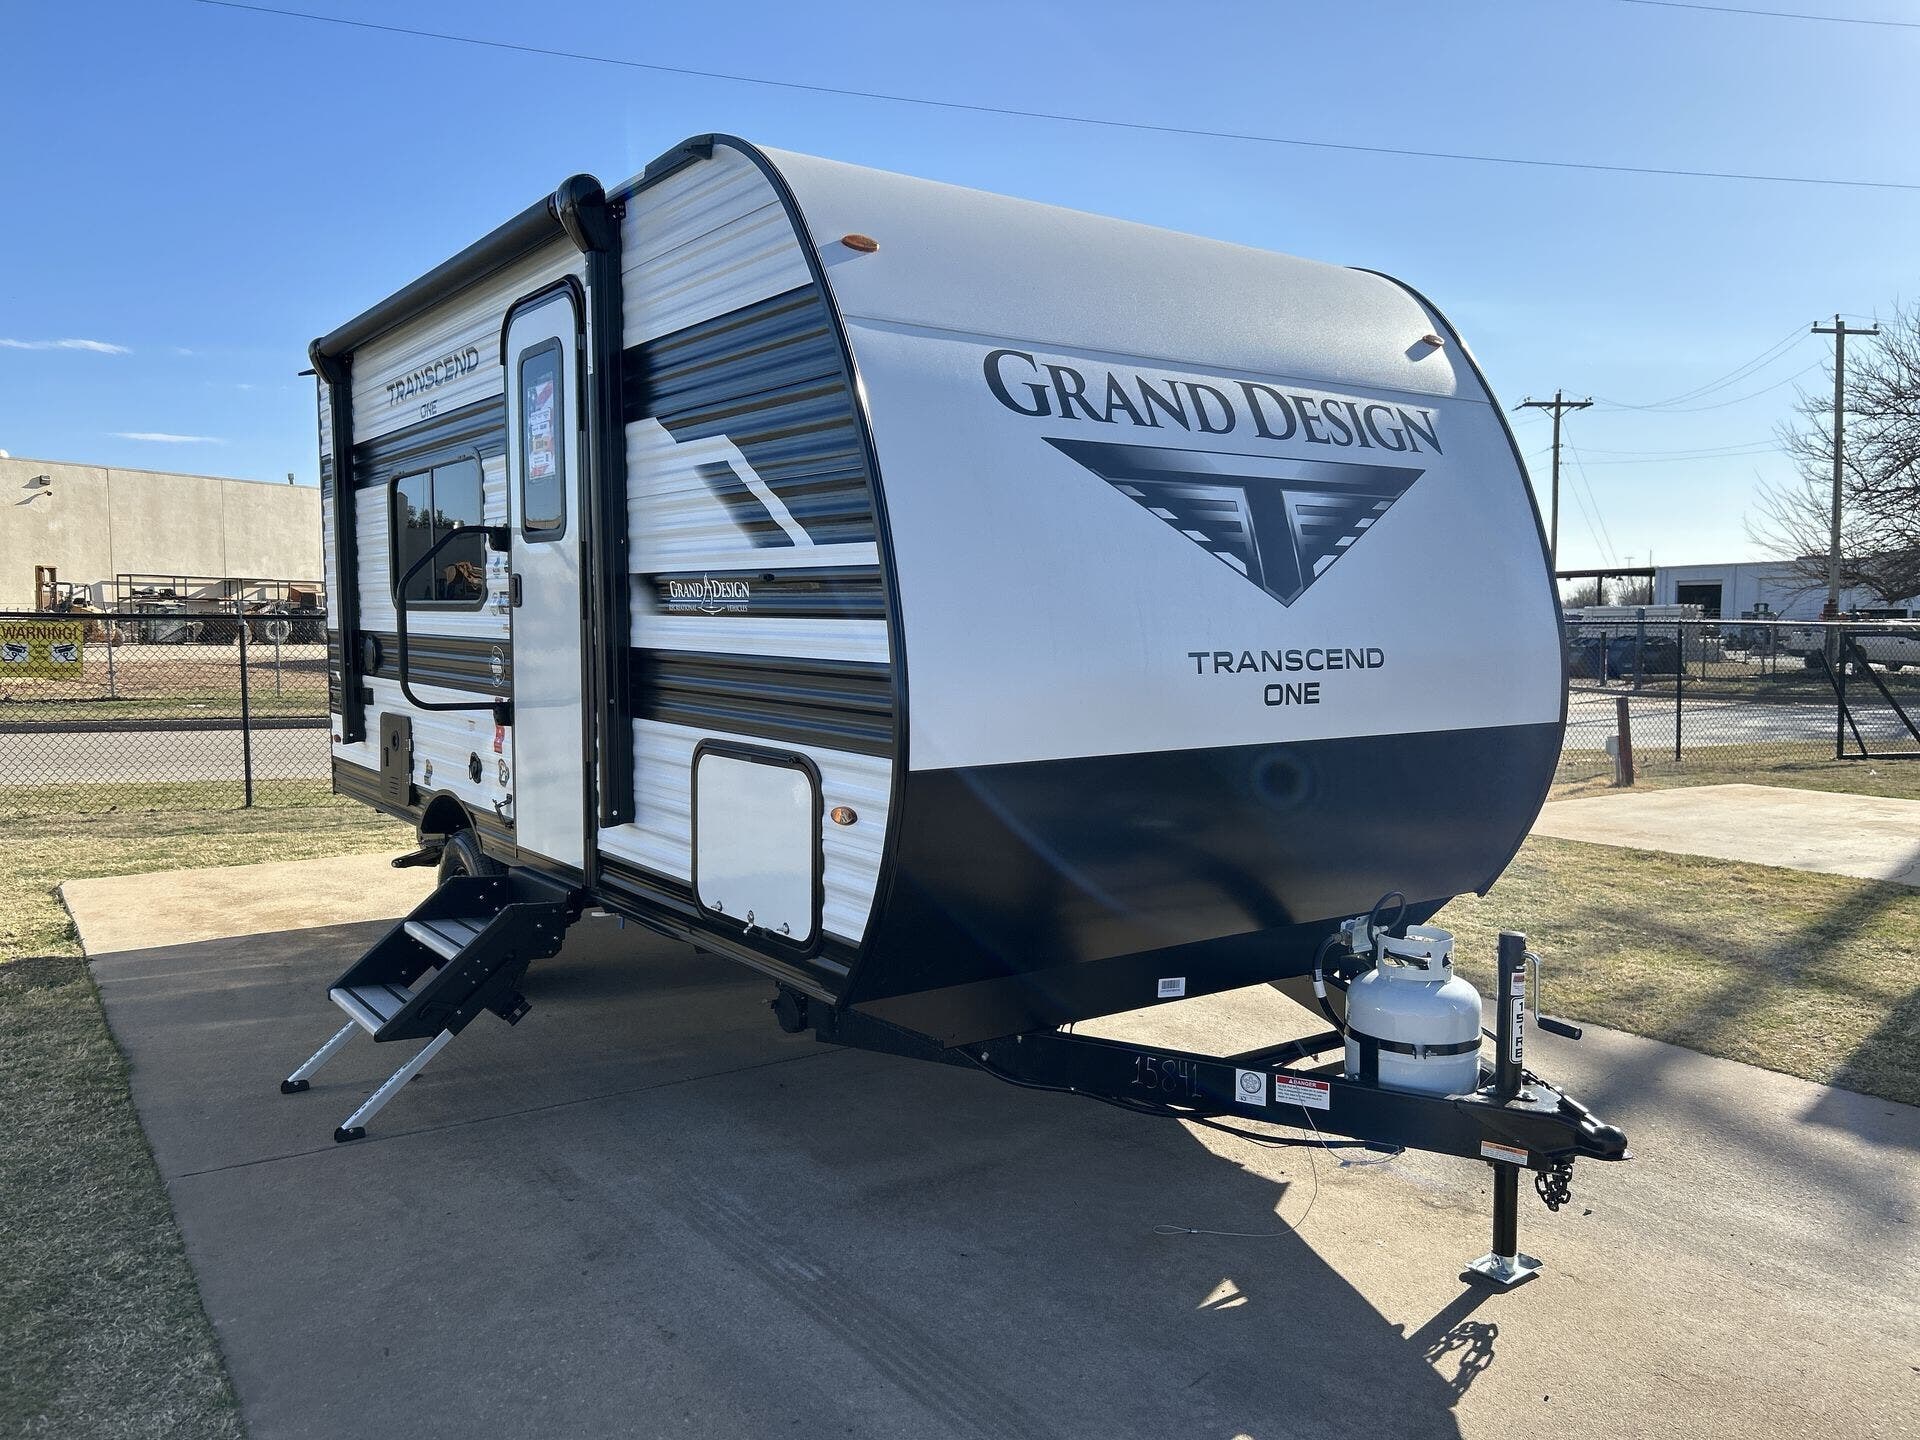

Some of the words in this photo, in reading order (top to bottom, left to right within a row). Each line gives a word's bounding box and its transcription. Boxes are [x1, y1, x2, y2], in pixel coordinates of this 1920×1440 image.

[386, 346, 479, 406] TRANSCEND
[420, 400, 438, 418] ONE
[983, 349, 1236, 434] GRAND
[1232, 380, 1444, 455] DESIGN
[669, 581, 704, 598] GRAND
[711, 580, 750, 598] DESIGN
[1, 626, 78, 640] WARNING!
[1187, 647, 1386, 675] TRANSCEND
[1263, 682, 1321, 706] ONE
[1131, 1055, 1202, 1097] 15841
